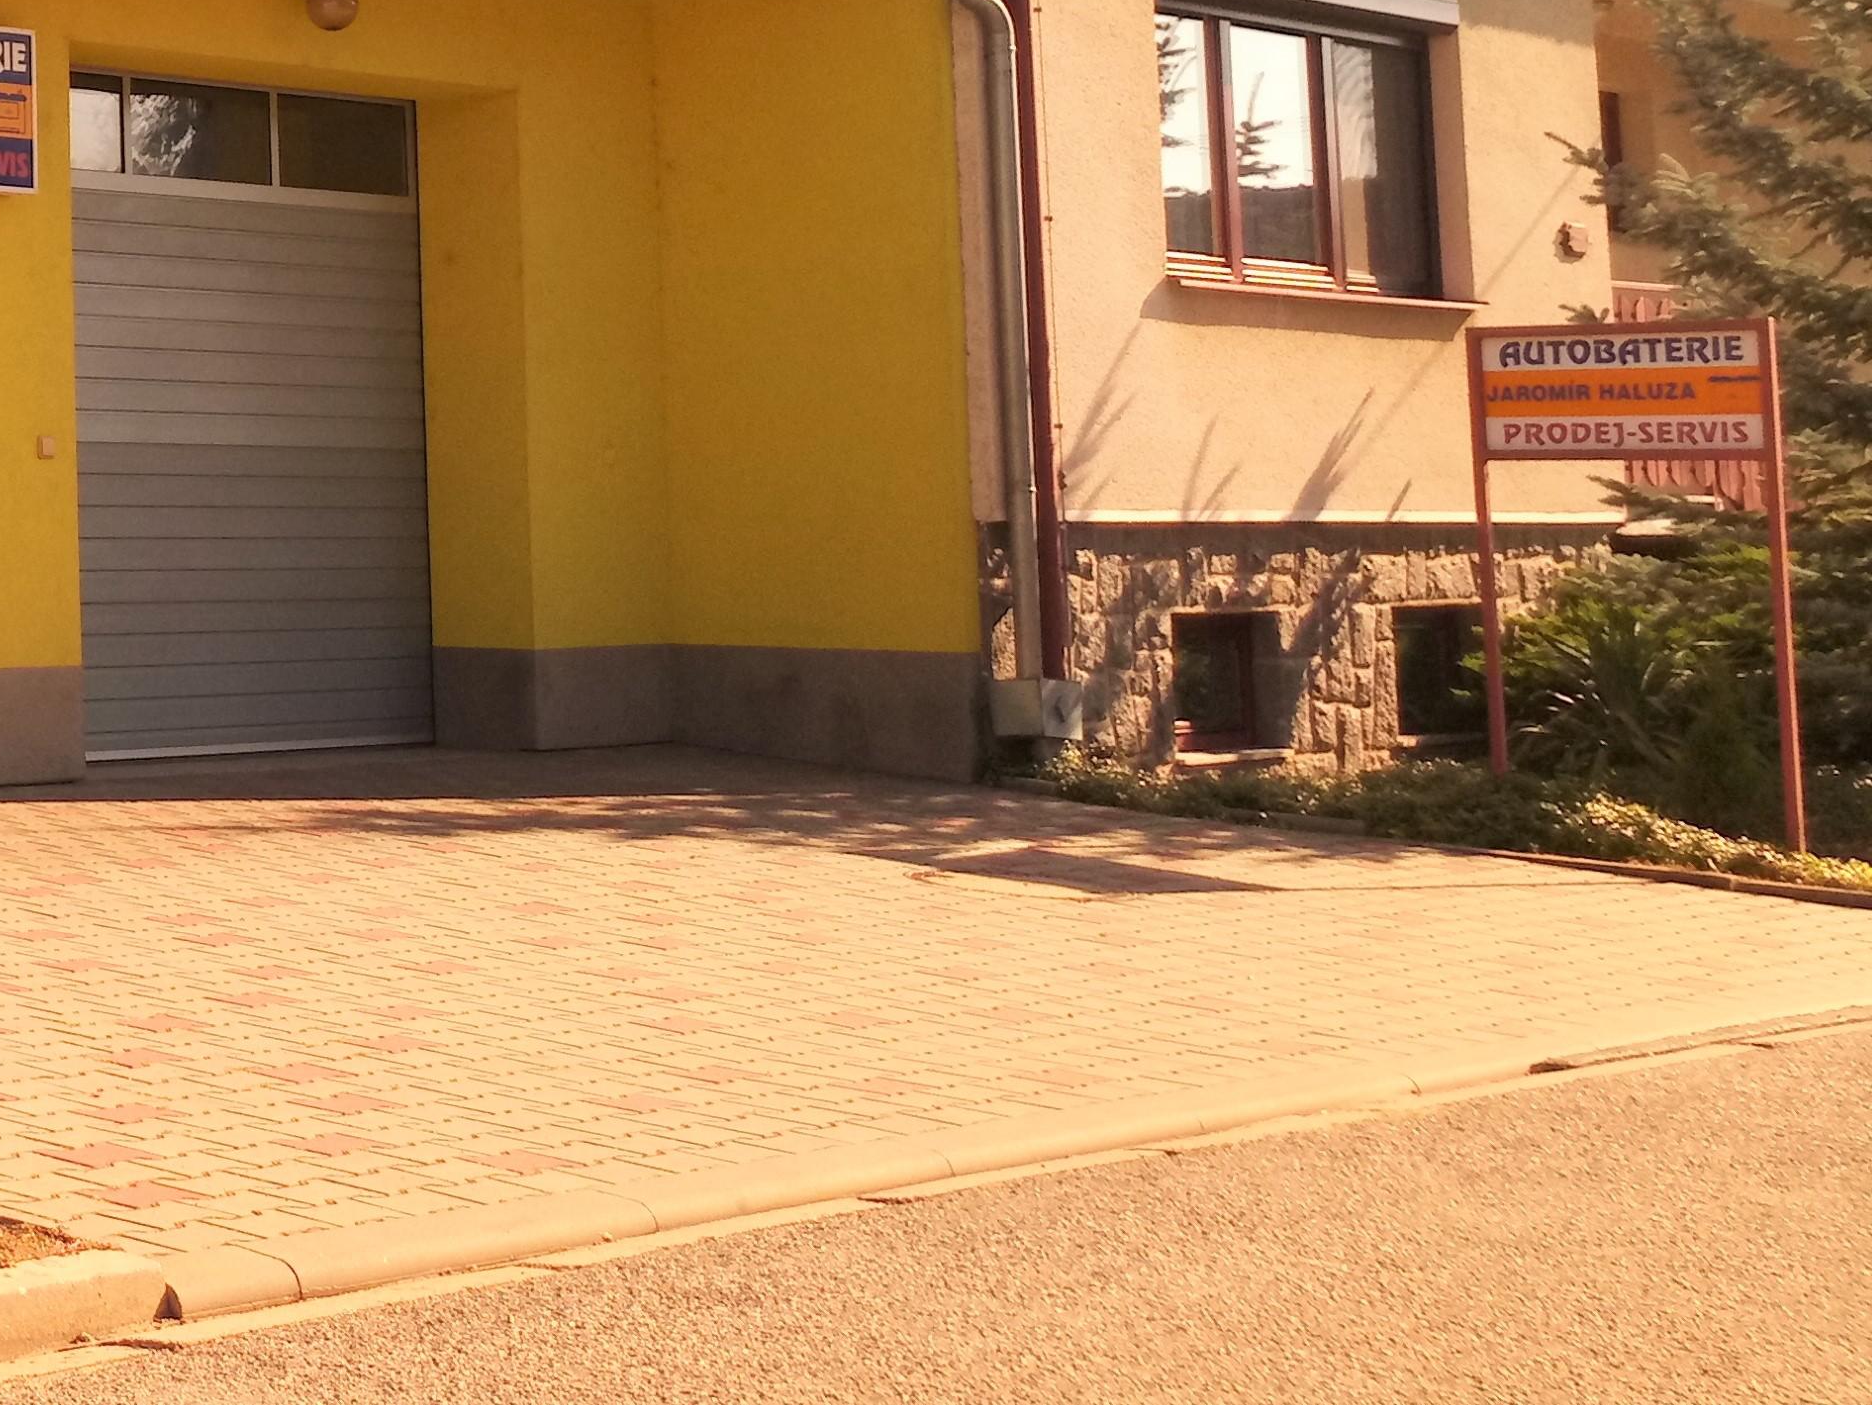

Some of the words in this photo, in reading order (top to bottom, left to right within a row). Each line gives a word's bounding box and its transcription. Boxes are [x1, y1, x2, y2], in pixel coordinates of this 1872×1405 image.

[1500, 336, 1744, 367] AUTOBATERIE
[1487, 380, 1591, 402] JAROMÍR
[1599, 383, 1696, 400] HALUZA
